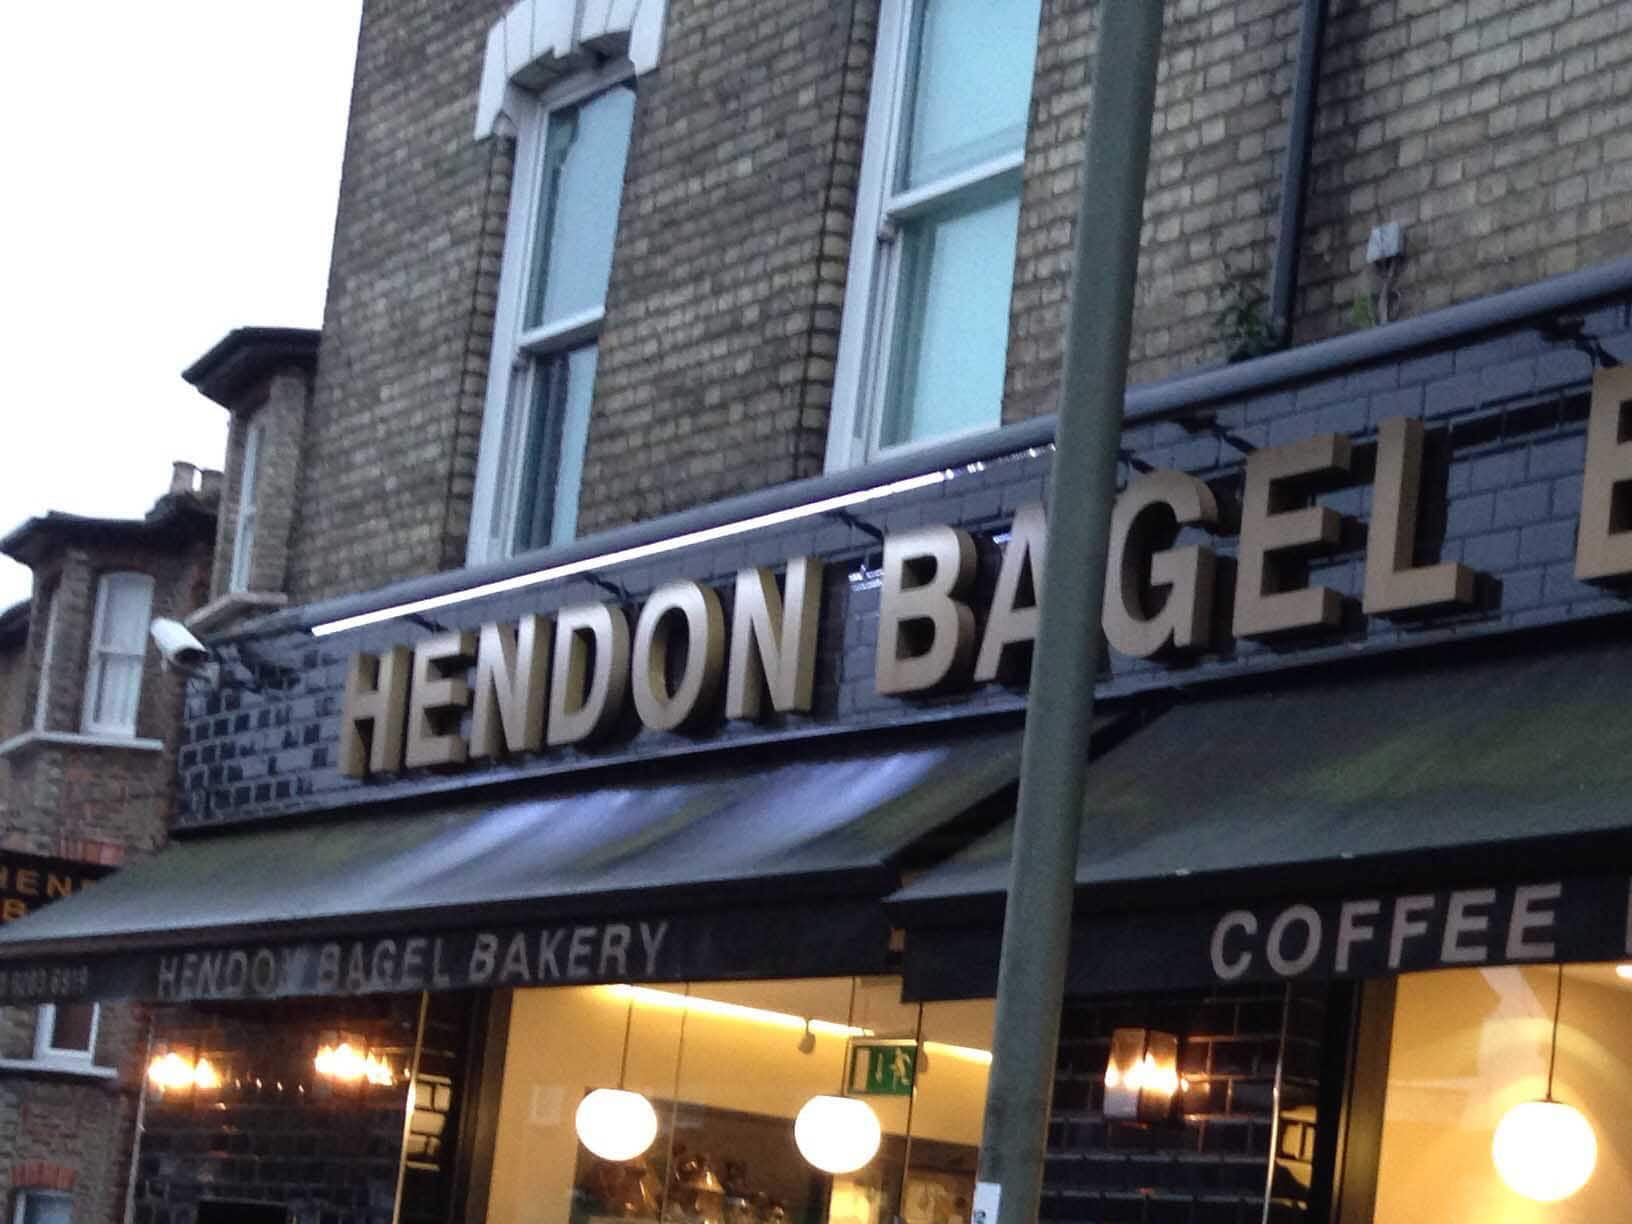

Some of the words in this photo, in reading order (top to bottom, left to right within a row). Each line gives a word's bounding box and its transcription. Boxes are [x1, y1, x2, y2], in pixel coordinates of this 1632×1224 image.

[338, 557, 824, 781] HENDON
[318, 935, 451, 994] BAGEL
[467, 920, 669, 985] BAKERY
[1209, 882, 1563, 981] COFFEE
